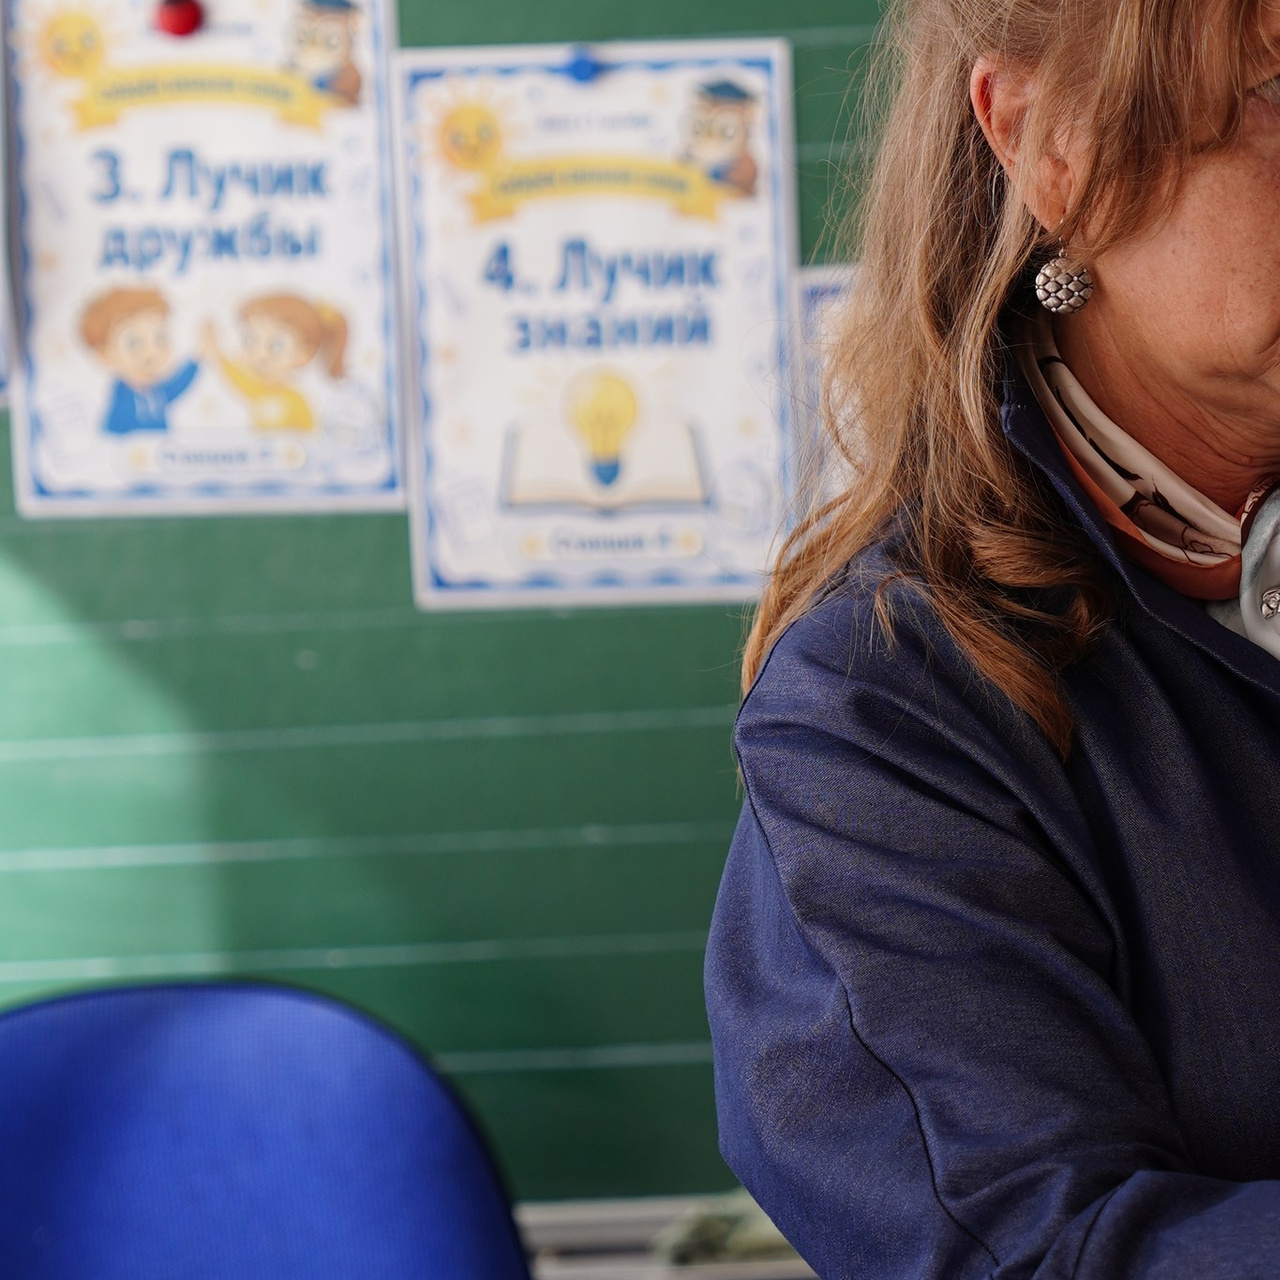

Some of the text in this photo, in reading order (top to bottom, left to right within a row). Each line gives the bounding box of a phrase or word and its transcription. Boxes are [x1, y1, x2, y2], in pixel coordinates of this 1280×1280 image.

[161, 148, 332, 213] Лучик
[98, 214, 322, 274] дружбы
[556, 239, 724, 304] Лучик
[510, 294, 713, 351] знаний
